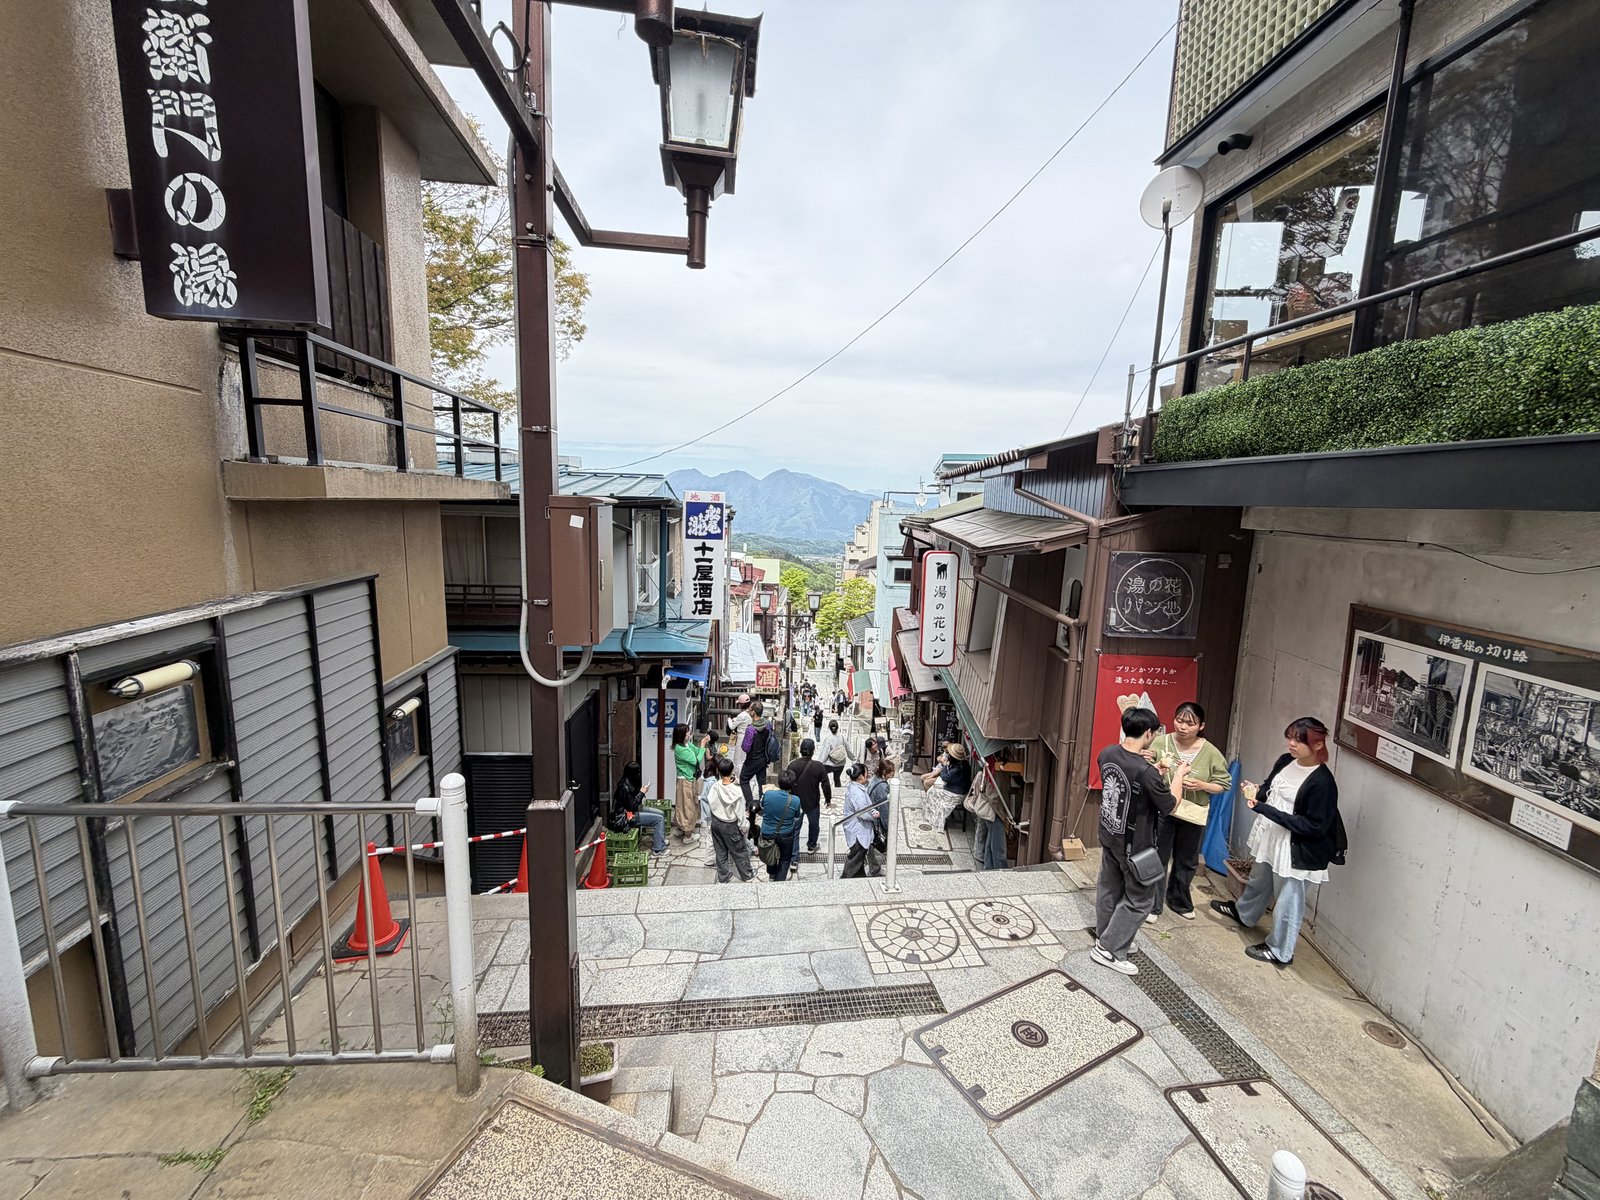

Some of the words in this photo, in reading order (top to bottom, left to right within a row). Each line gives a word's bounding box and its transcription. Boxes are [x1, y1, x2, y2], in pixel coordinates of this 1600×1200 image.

[692, 541, 715, 615] 十一屋酒店
[930, 585, 947, 659] 湯の花パン
[1437, 633, 1528, 663] 伊香保の切り絵
[758, 667, 777, 686] 酒
